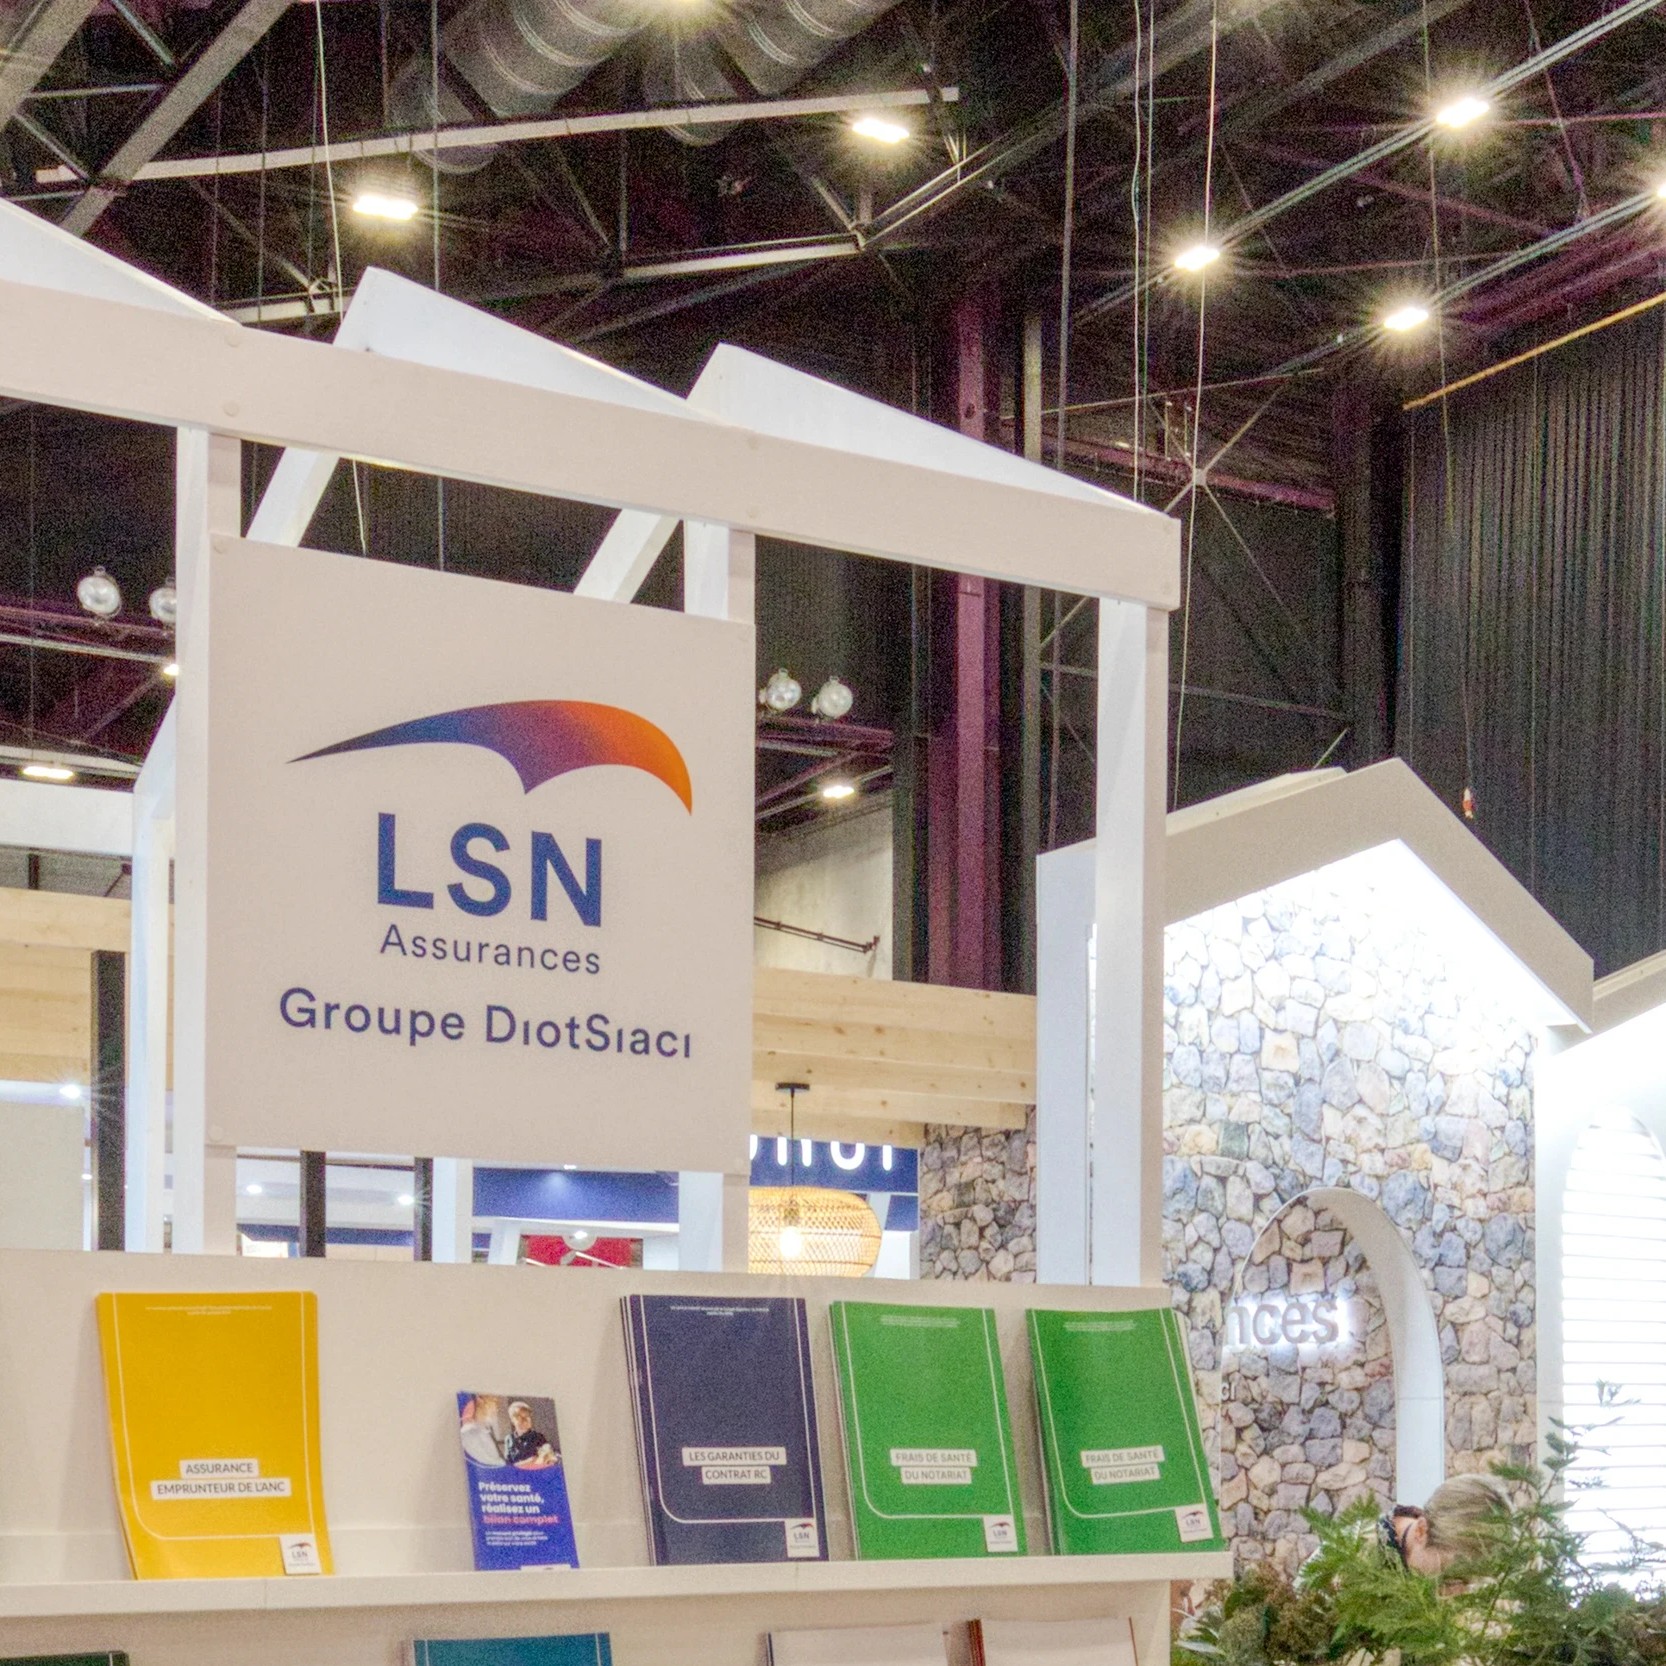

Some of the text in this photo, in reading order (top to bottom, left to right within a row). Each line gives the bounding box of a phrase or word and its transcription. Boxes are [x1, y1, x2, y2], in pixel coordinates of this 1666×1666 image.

[377, 812, 602, 927] LSN
[379, 923, 601, 975] Assurances
[279, 987, 465, 1045] Groupe
[689, 1451, 779, 1461] LES GARANTIES DU
[896, 1452, 972, 1462] FRAIS DE SANTÉ
[1086, 1450, 1158, 1463] FRAIS DE SANTÉ
[186, 1463, 253, 1474] ASSURANCE
[705, 1469, 767, 1479] CONTRAT RC
[1095, 1467, 1155, 1480] DU NOTARIAT
[905, 1470, 967, 1479] DU NOTARIAT
[157, 1482, 235, 1495] EMPRUNTEUR
[238, 1482, 252, 1493] DE
[478, 1481, 531, 1492] Préservez
[480, 1493, 544, 1504] votre santé,
[481, 1503, 540, 1513] réalisez un
